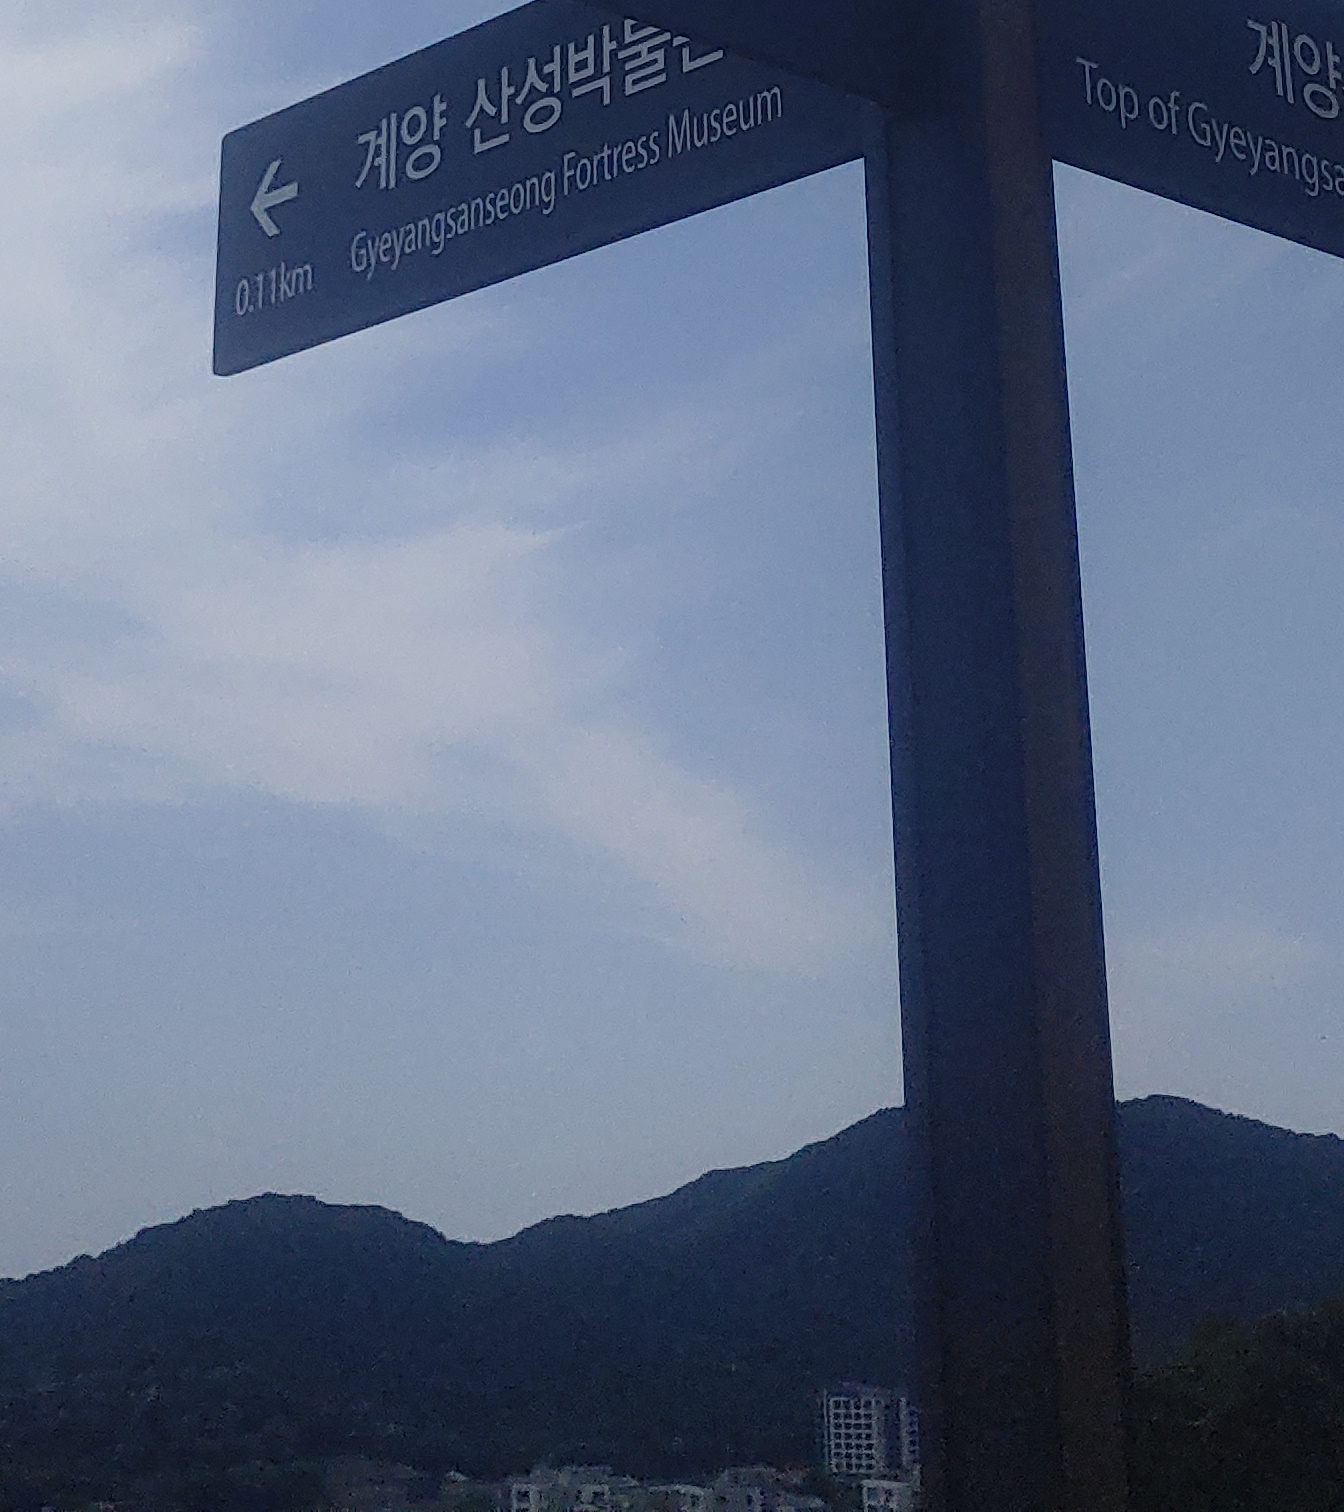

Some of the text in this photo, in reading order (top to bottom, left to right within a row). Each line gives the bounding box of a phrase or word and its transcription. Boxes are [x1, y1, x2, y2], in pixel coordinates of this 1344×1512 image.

[1075, 56, 1140, 128] Top
[1148, 90, 1181, 135] of
[350, 85, 783, 279] Gyeyangsanseong Fortress Museum
[355, 94, 448, 191] 계양
[234, 260, 314, 317] 0.11km
